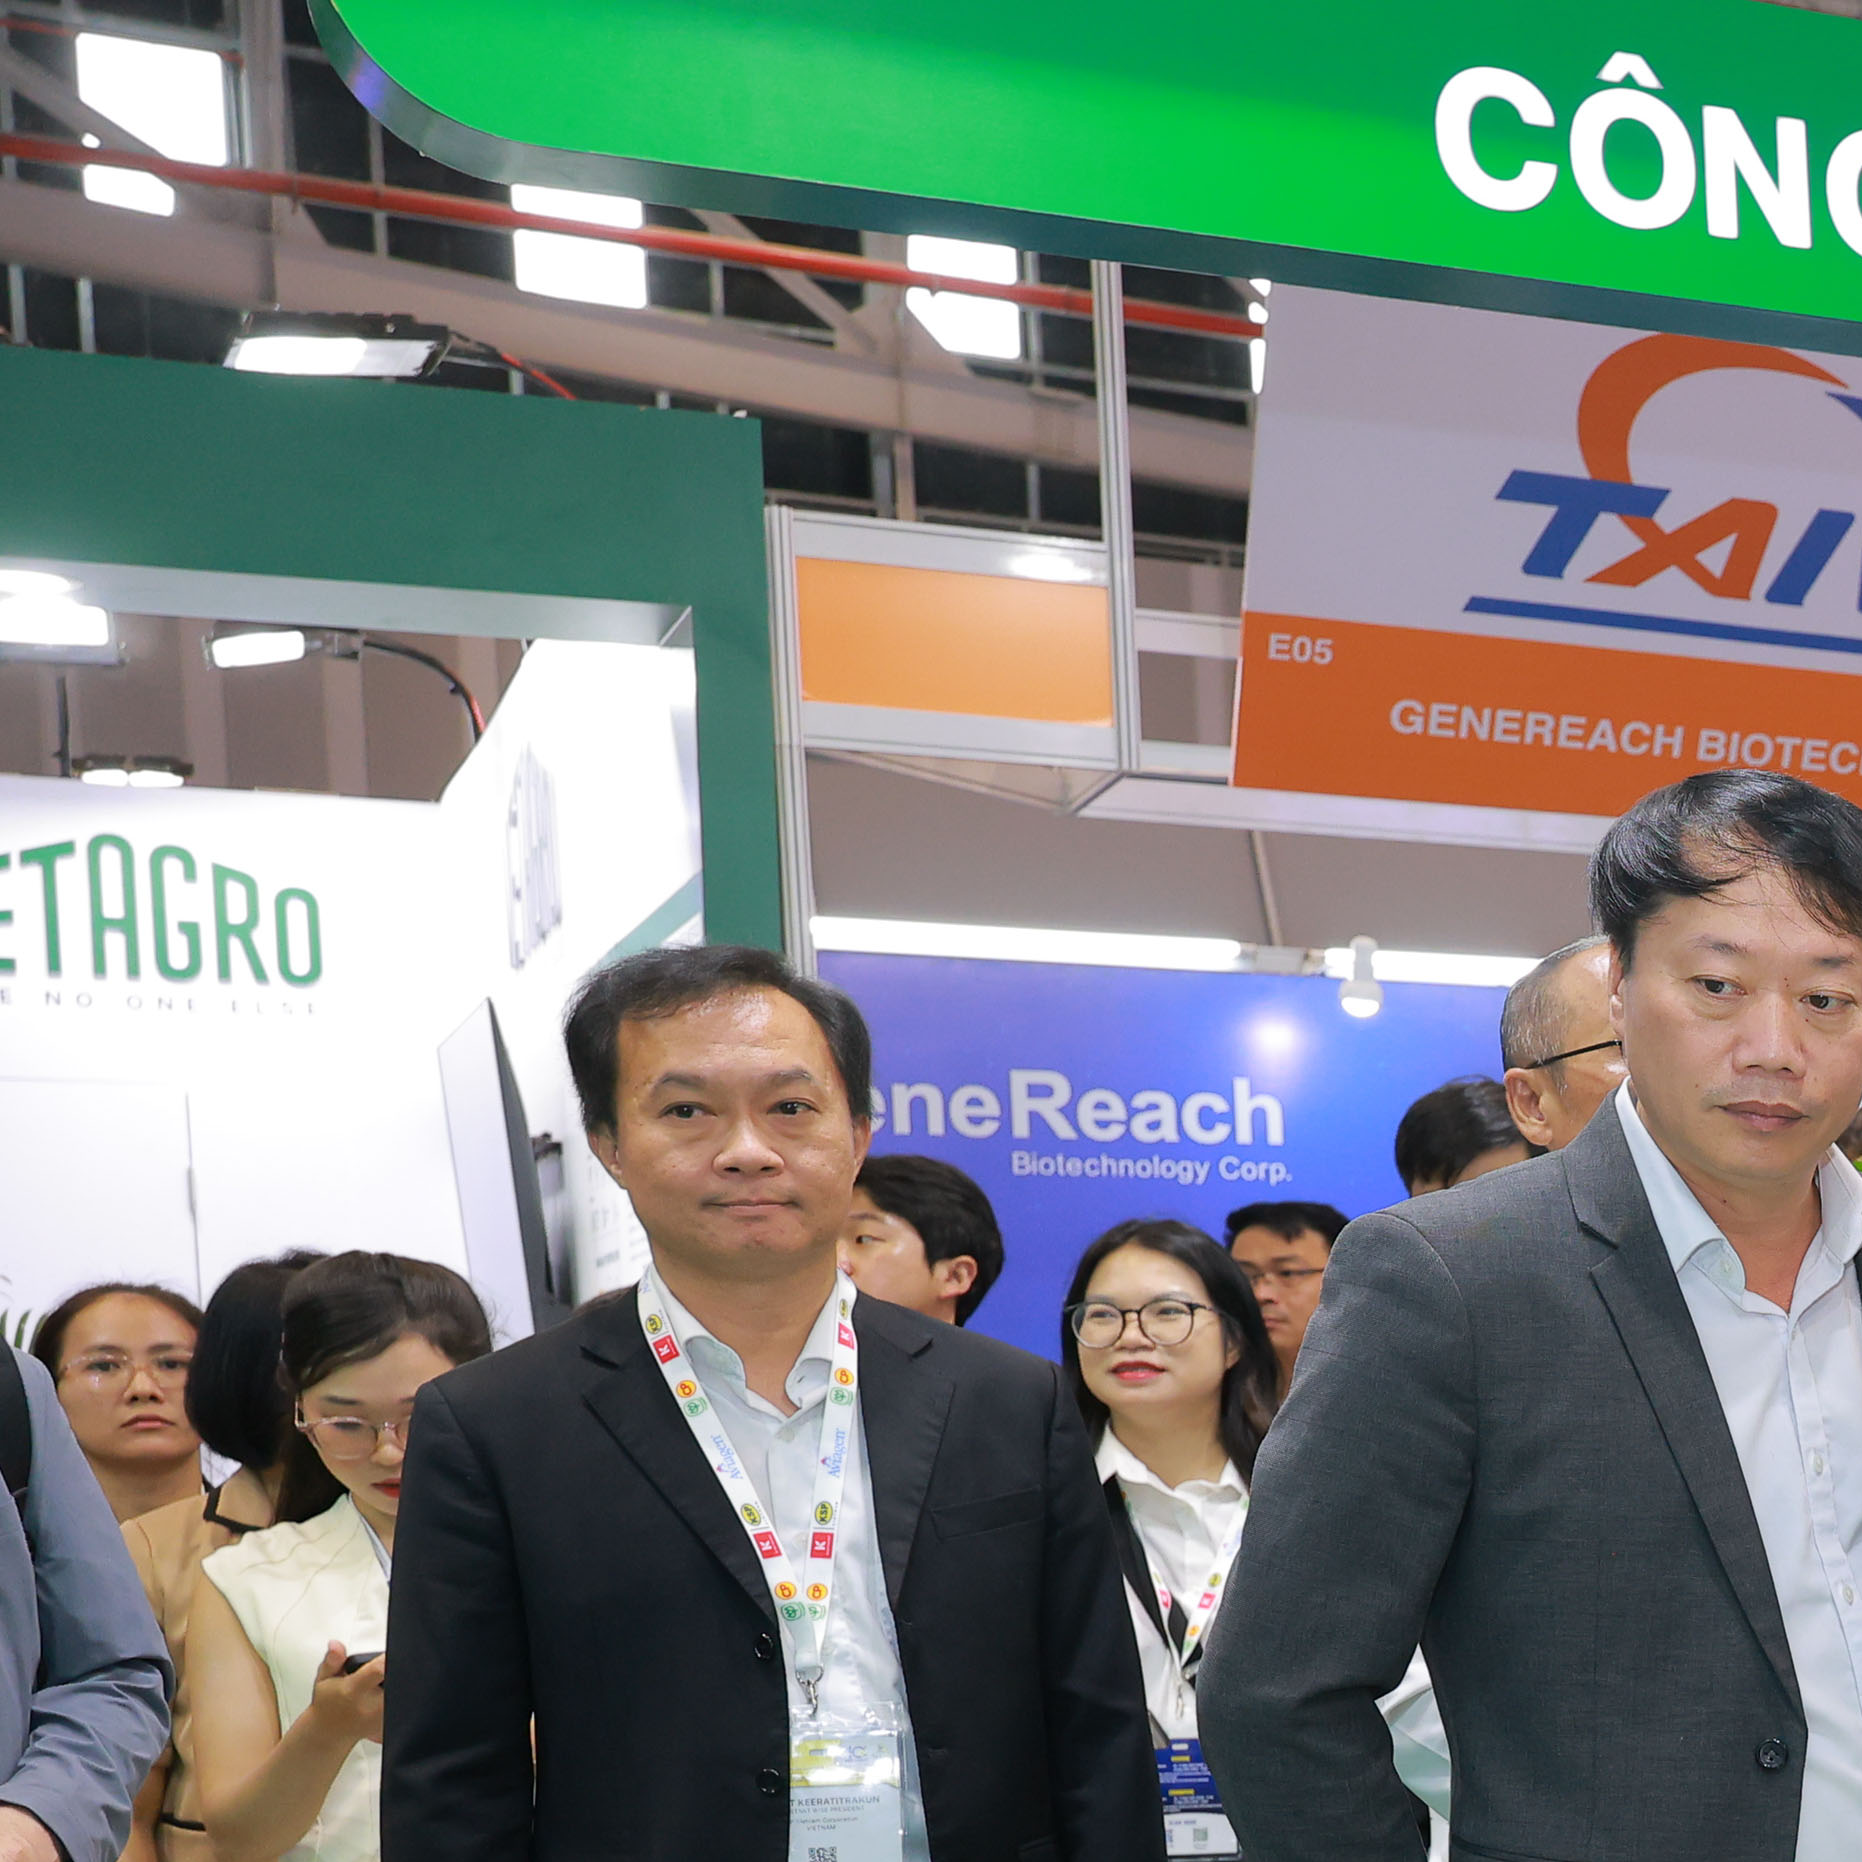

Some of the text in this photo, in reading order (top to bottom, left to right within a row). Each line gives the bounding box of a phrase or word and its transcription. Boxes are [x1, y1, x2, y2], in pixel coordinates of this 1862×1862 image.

[1267, 635, 1334, 666] E05
[1390, 698, 1685, 761] GENEREACH
[1012, 1151, 1292, 1186] Biotechnology Corp.
[817, 1503, 830, 1523] KSP
